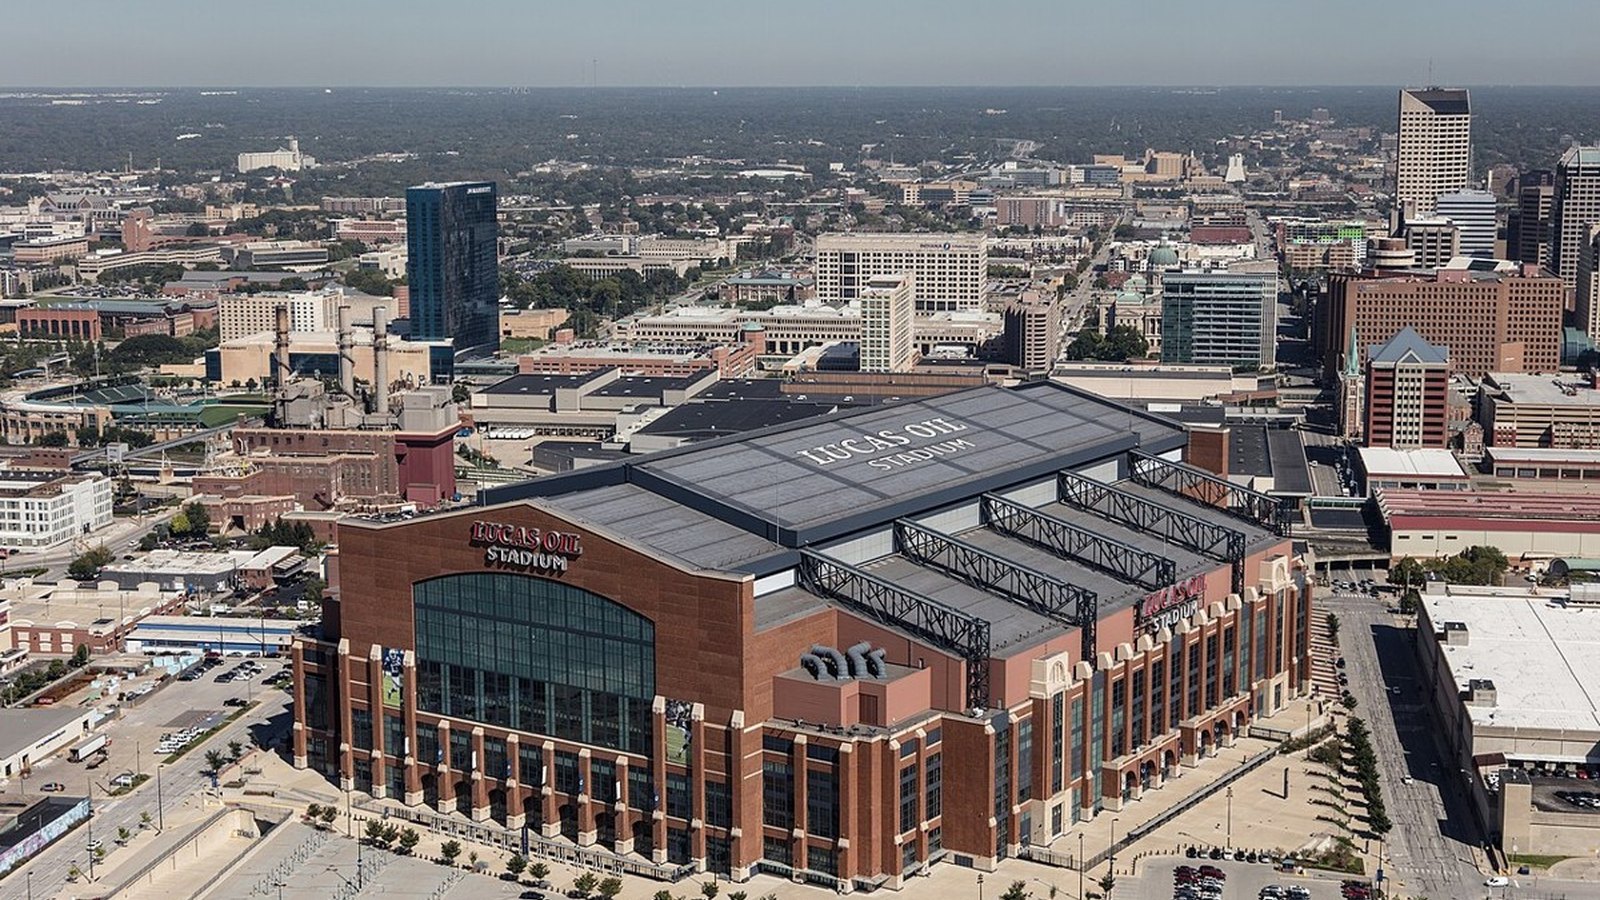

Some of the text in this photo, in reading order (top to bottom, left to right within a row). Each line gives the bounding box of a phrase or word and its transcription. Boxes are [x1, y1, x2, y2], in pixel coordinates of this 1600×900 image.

[797, 418, 968, 466] LUCAS OIL
[867, 437, 976, 471] STADIUM
[472, 520, 584, 555] LUCAS OIL
[486, 545, 568, 572] STADIUM
[1153, 600, 1198, 632] STADIUM
